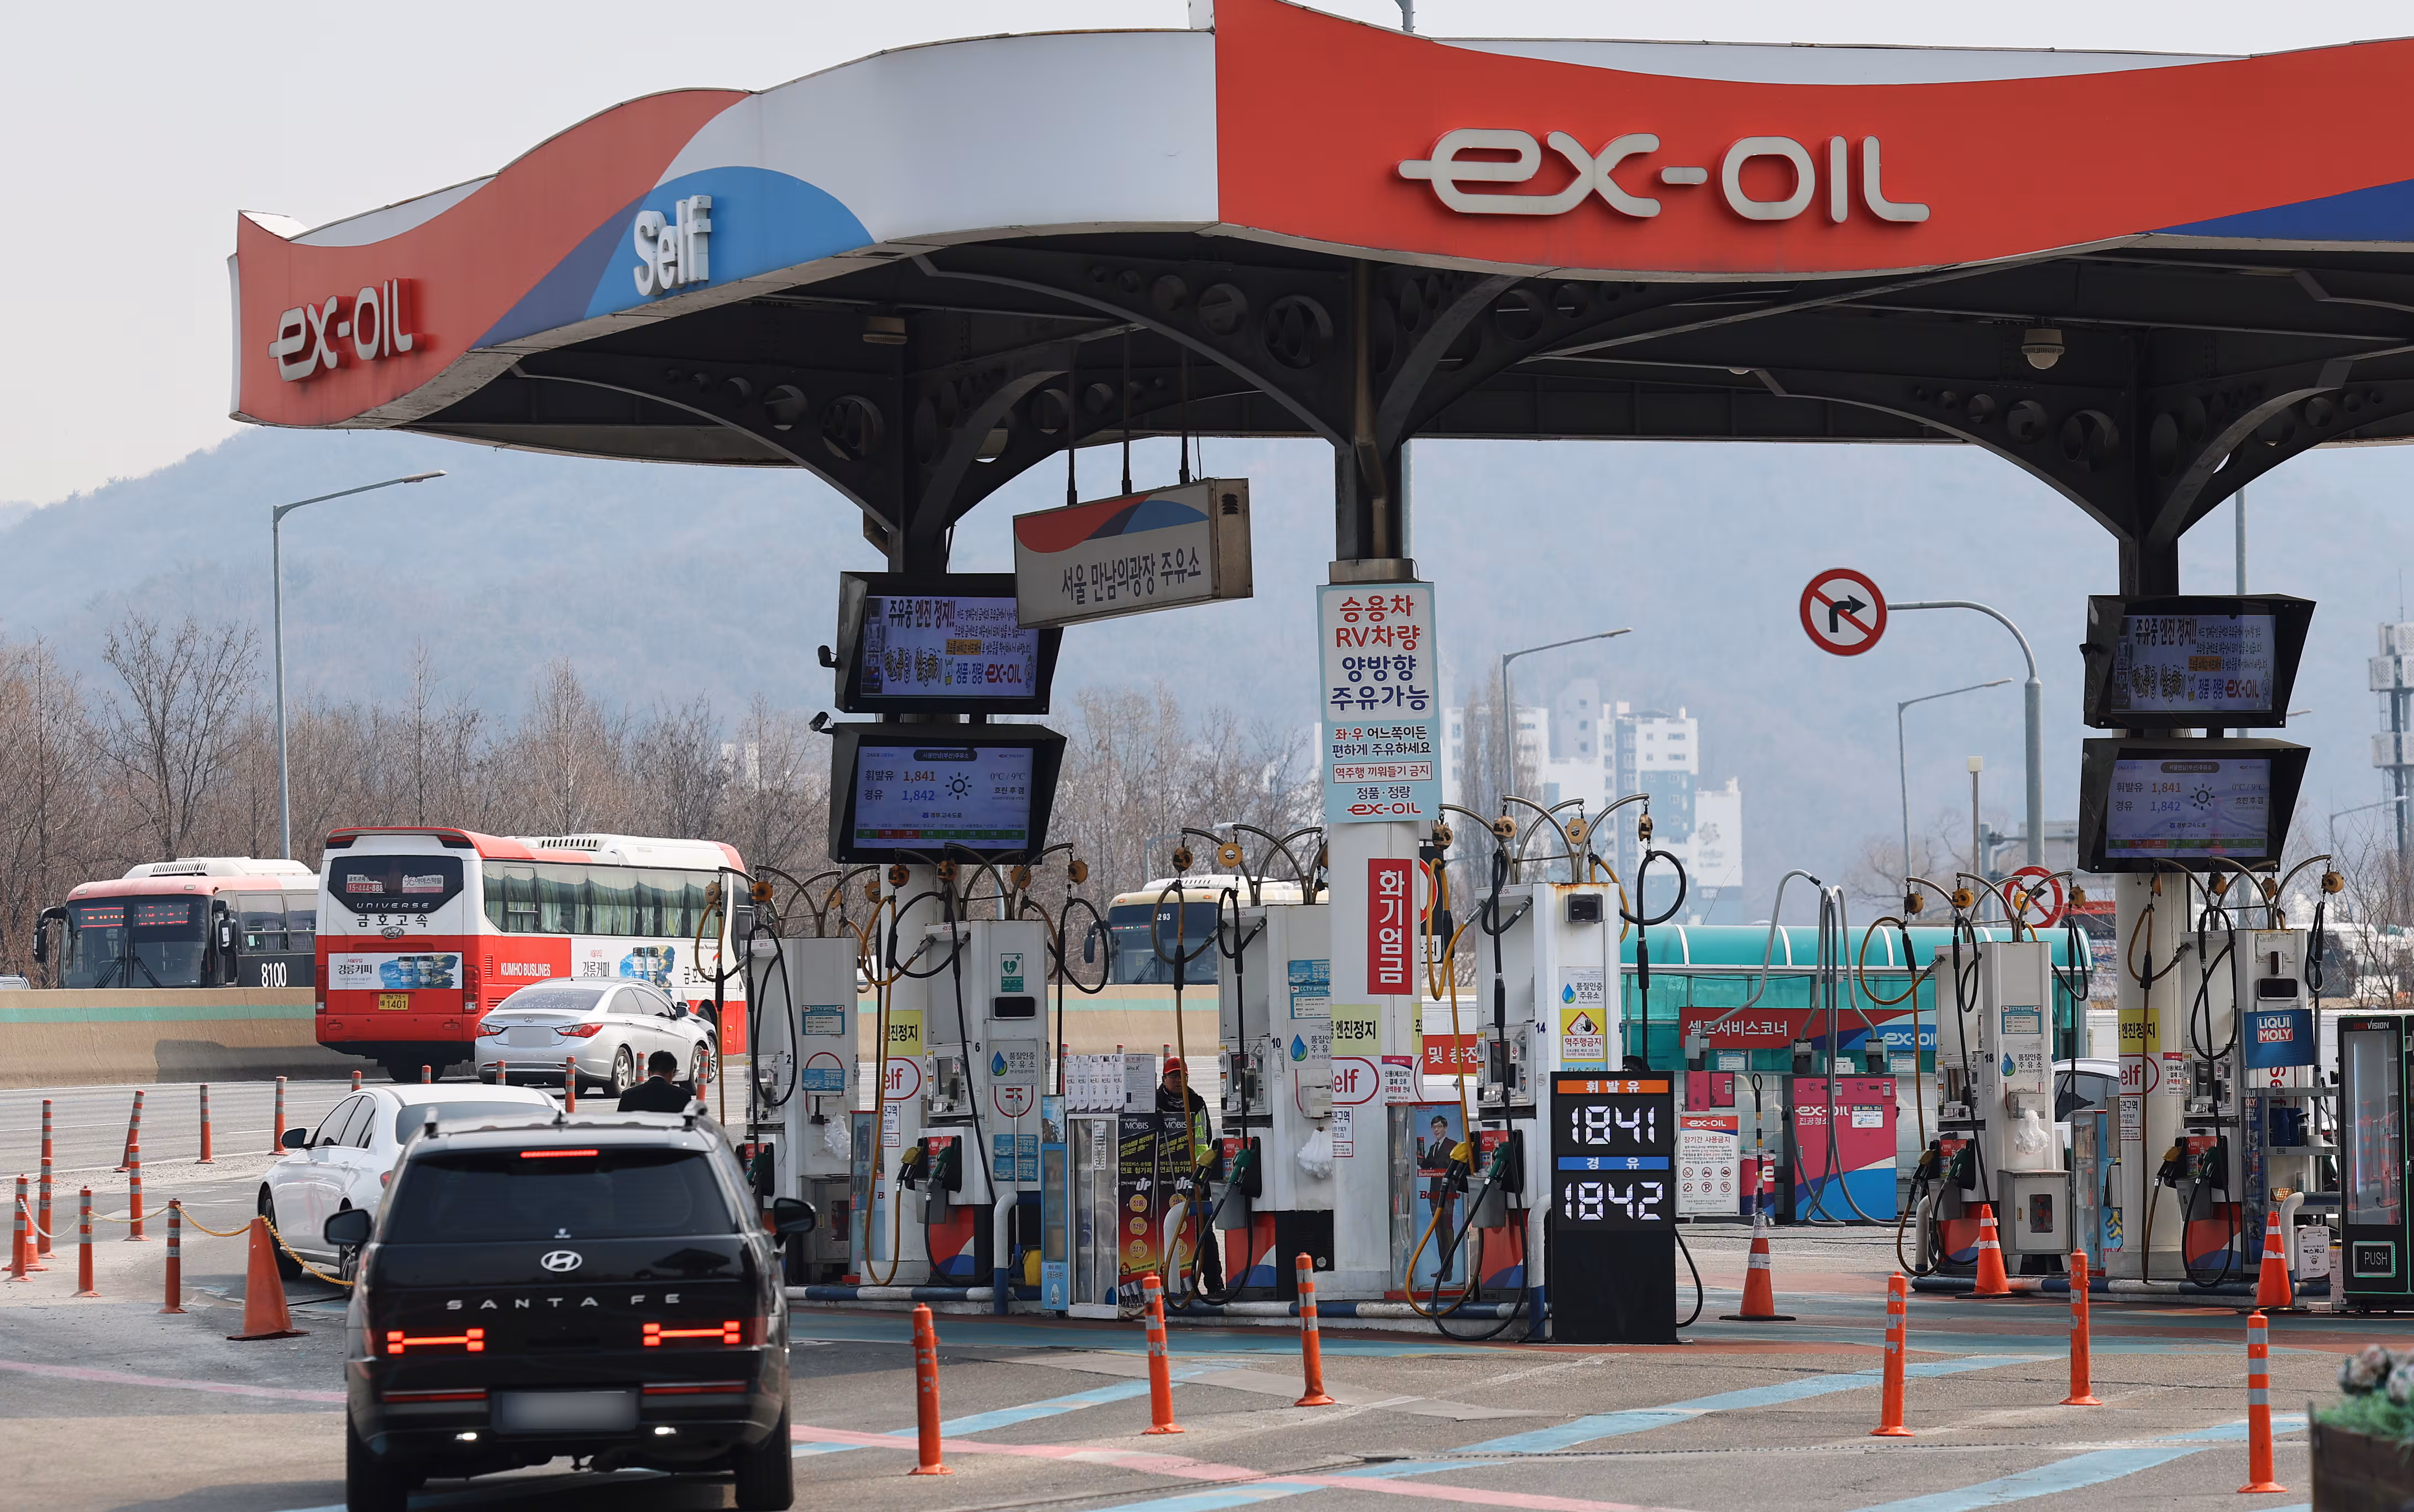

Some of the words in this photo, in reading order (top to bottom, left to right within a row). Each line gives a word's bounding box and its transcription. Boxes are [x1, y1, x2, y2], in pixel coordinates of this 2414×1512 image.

[1393, 127, 1930, 223] ex-OIL
[633, 195, 712, 296] Self
[268, 278, 413, 382] ex-OIL
[1062, 568, 1087, 605] 서울
[1090, 553, 1155, 601] 만남의광장
[1160, 547, 1201, 586] 주유소
[889, 600, 913, 628] 주유중
[915, 600, 932, 628] 엔진
[934, 600, 956, 629] 정지!!
[1340, 594, 1415, 623] 승용차
[1336, 624, 1421, 651] RV차량
[2135, 618, 2158, 646] 주유중
[2160, 618, 2175, 645] 엔진
[2177, 618, 2197, 646] 정지!!
[985, 663, 1021, 684] ex-OIL
[1342, 654, 1416, 683] 양방향
[2225, 679, 2259, 698] ex-OIL
[1330, 685, 1430, 711] 주유가능
[1367, 726, 1428, 741] 어느쪽이든
[1332, 743, 1368, 758] 편하게
[1371, 742, 1432, 757] 주유하세요
[865, 770, 894, 781] 휘발유
[903, 770, 936, 784] 1,841
[1335, 767, 1365, 779] 역주행
[1367, 765, 1407, 778] 끼워들기
[1409, 765, 1429, 776] 금지
[864, 789, 884, 800] 경유
[902, 790, 935, 803] 1,842
[994, 786, 1007, 795] 흐린
[2116, 783, 2143, 792] 휘발유
[2151, 783, 2181, 795] 1,841
[2116, 801, 2133, 811] 경유
[2150, 801, 2181, 813] 1,842
[2235, 796, 2248, 805] 흐린
[2250, 796, 2256, 805] 후
[1347, 802, 1422, 816] ex-OIL
[1379, 869, 1405, 984] 화기엄금
[261, 962, 287, 988] 8100
[338, 964, 372, 975] 강릉커피
[500, 963, 522, 977] KUMHO
[523, 963, 552, 977] BUSLINES
[1576, 982, 1603, 991] 품질인증
[1579, 991, 1600, 1000] 주유소
[387, 1000, 407, 1008] 1401
[1336, 1020, 1376, 1040] 엔진정지
[1536, 1022, 1546, 1033] 14
[2122, 1022, 2156, 1039] 엔진정지
[2258, 1017, 2291, 1030] LIQUI
[1311, 1036, 1331, 1044] 품질인
[2259, 1028, 2292, 1041] MOLY
[975, 1042, 980, 1052] 6
[1271, 1038, 1281, 1049] 10
[1311, 1044, 1329, 1053] 주유
[1565, 1037, 1601, 1047] 역주행금지
[786, 1054, 791, 1063] 2
[1428, 1046, 1444, 1064] 및
[1985, 1053, 1994, 1063] 18
[884, 1068, 904, 1090] elf
[2120, 1064, 2142, 1086] elf
[1586, 1080, 1640, 1093] 휘발유
[1572, 1106, 1655, 1144] 1841
[1705, 1136, 1730, 1144] 사용금지
[1136, 1177, 1152, 1191] UP
[1565, 1182, 1663, 1220] 1842
[2364, 1252, 2387, 1266] PUSH
[447, 1296, 599, 1310] SANTA
[631, 1293, 680, 1305] FE
